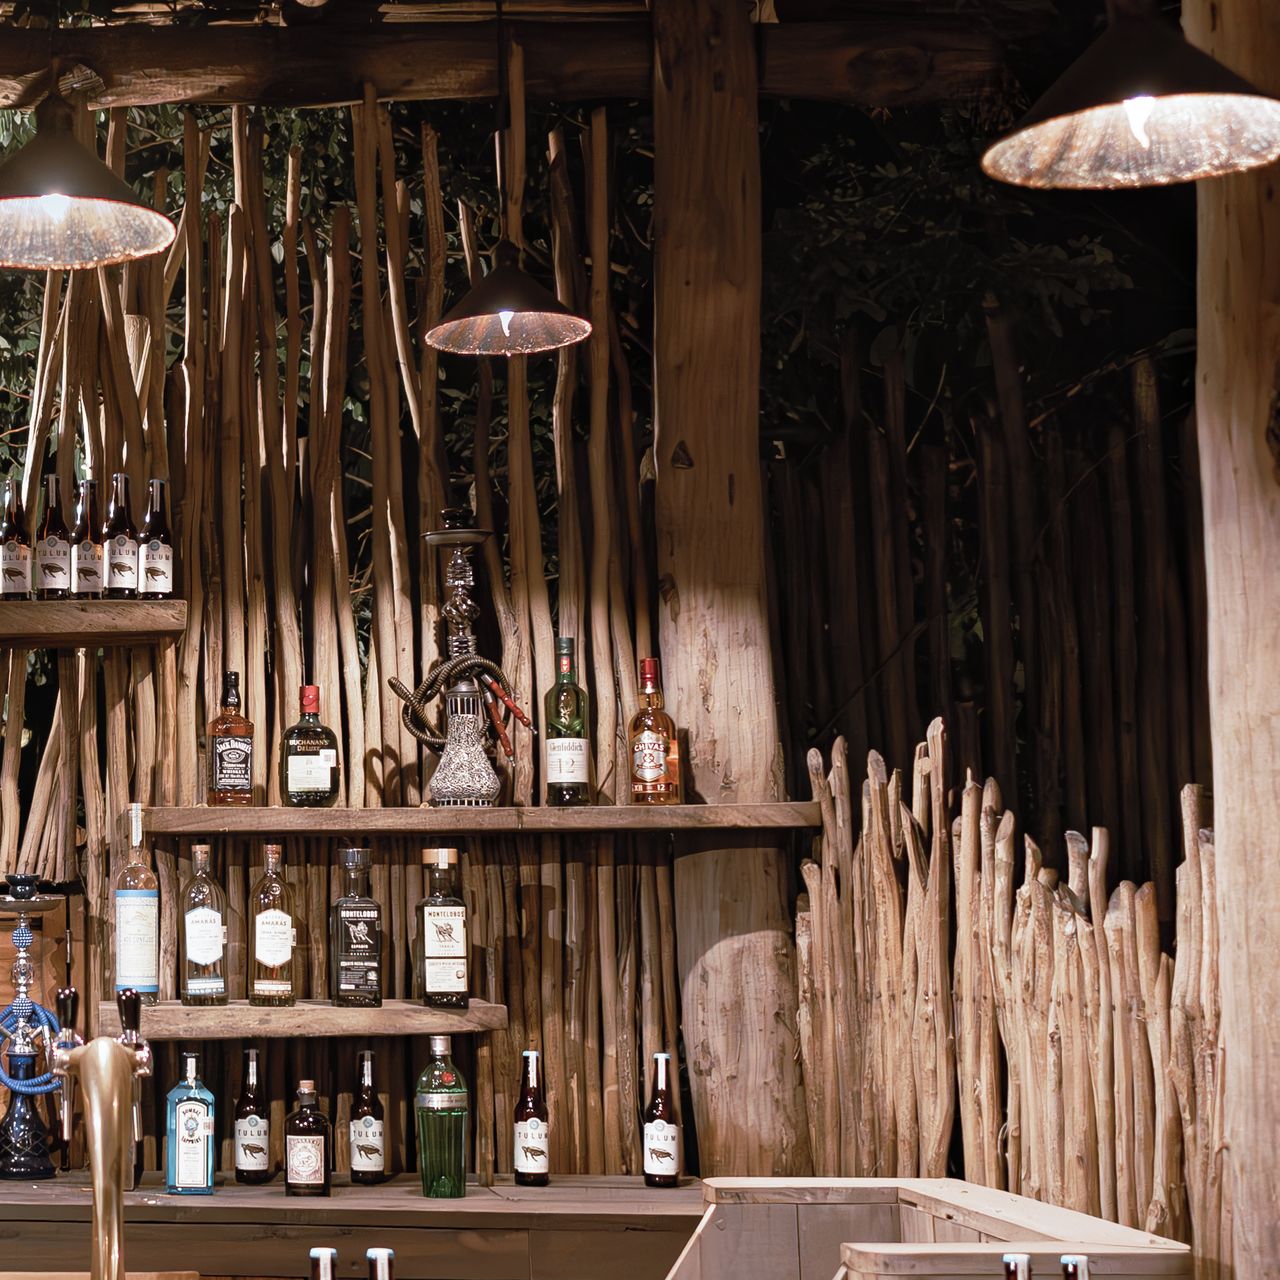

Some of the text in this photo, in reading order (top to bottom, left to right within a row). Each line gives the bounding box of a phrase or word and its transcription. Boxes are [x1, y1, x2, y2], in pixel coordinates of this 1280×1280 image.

[216, 741, 231, 753] JACK
[634, 743, 665, 752] CHIVAS
[558, 758, 575, 773] 12
[428, 910, 465, 918] MONTELOBOS
[646, 1133, 676, 1142] TULUM
